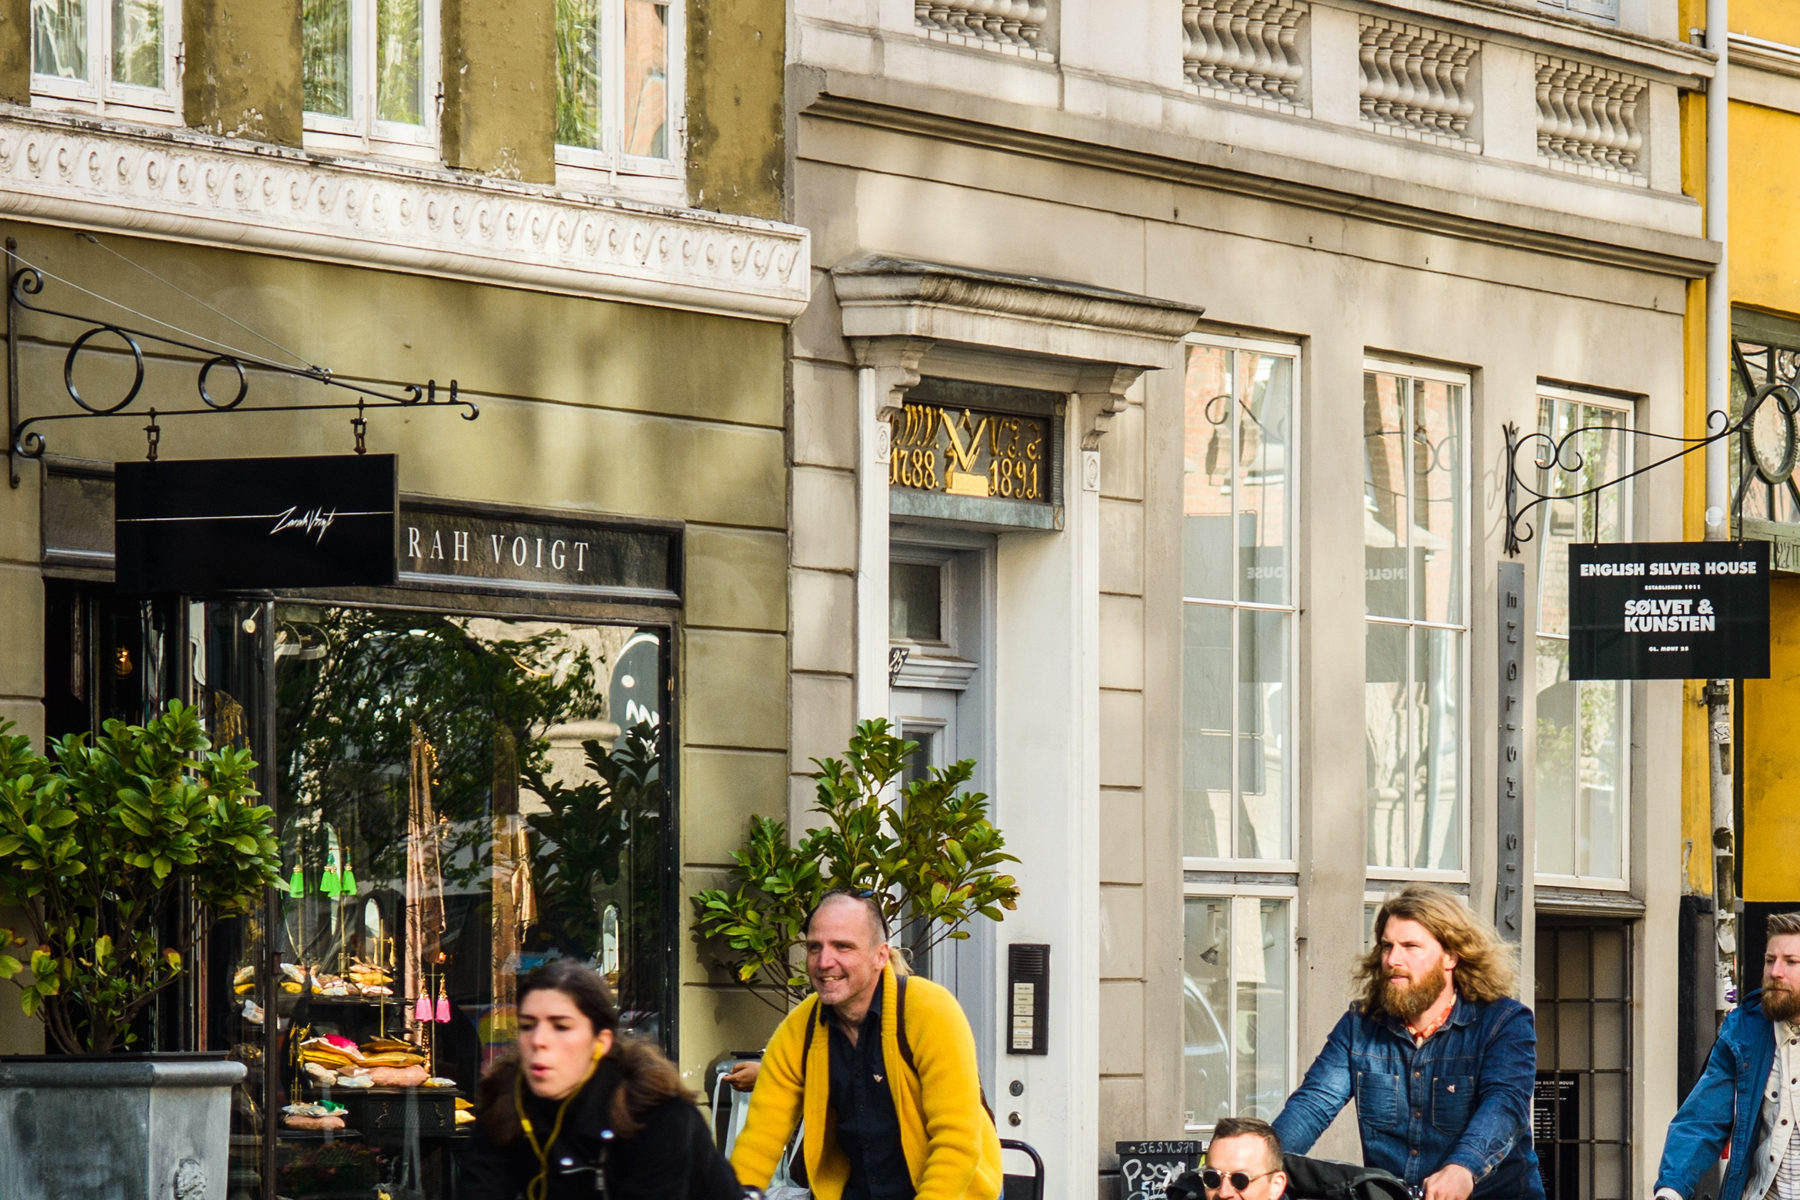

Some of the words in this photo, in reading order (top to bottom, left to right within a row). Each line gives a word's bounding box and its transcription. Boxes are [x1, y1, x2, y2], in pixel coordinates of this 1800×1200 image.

[407, 526, 469, 562] RAH
[491, 533, 589, 572] VOIGT
[1580, 563, 1646, 577] ENGLISH
[1649, 562, 1702, 576] SILVER
[1705, 561, 1757, 575] HOUSE
[1624, 598, 1693, 616] SØLVET
[1697, 598, 1714, 615] &
[1624, 616, 1716, 633] KUNSTEN
